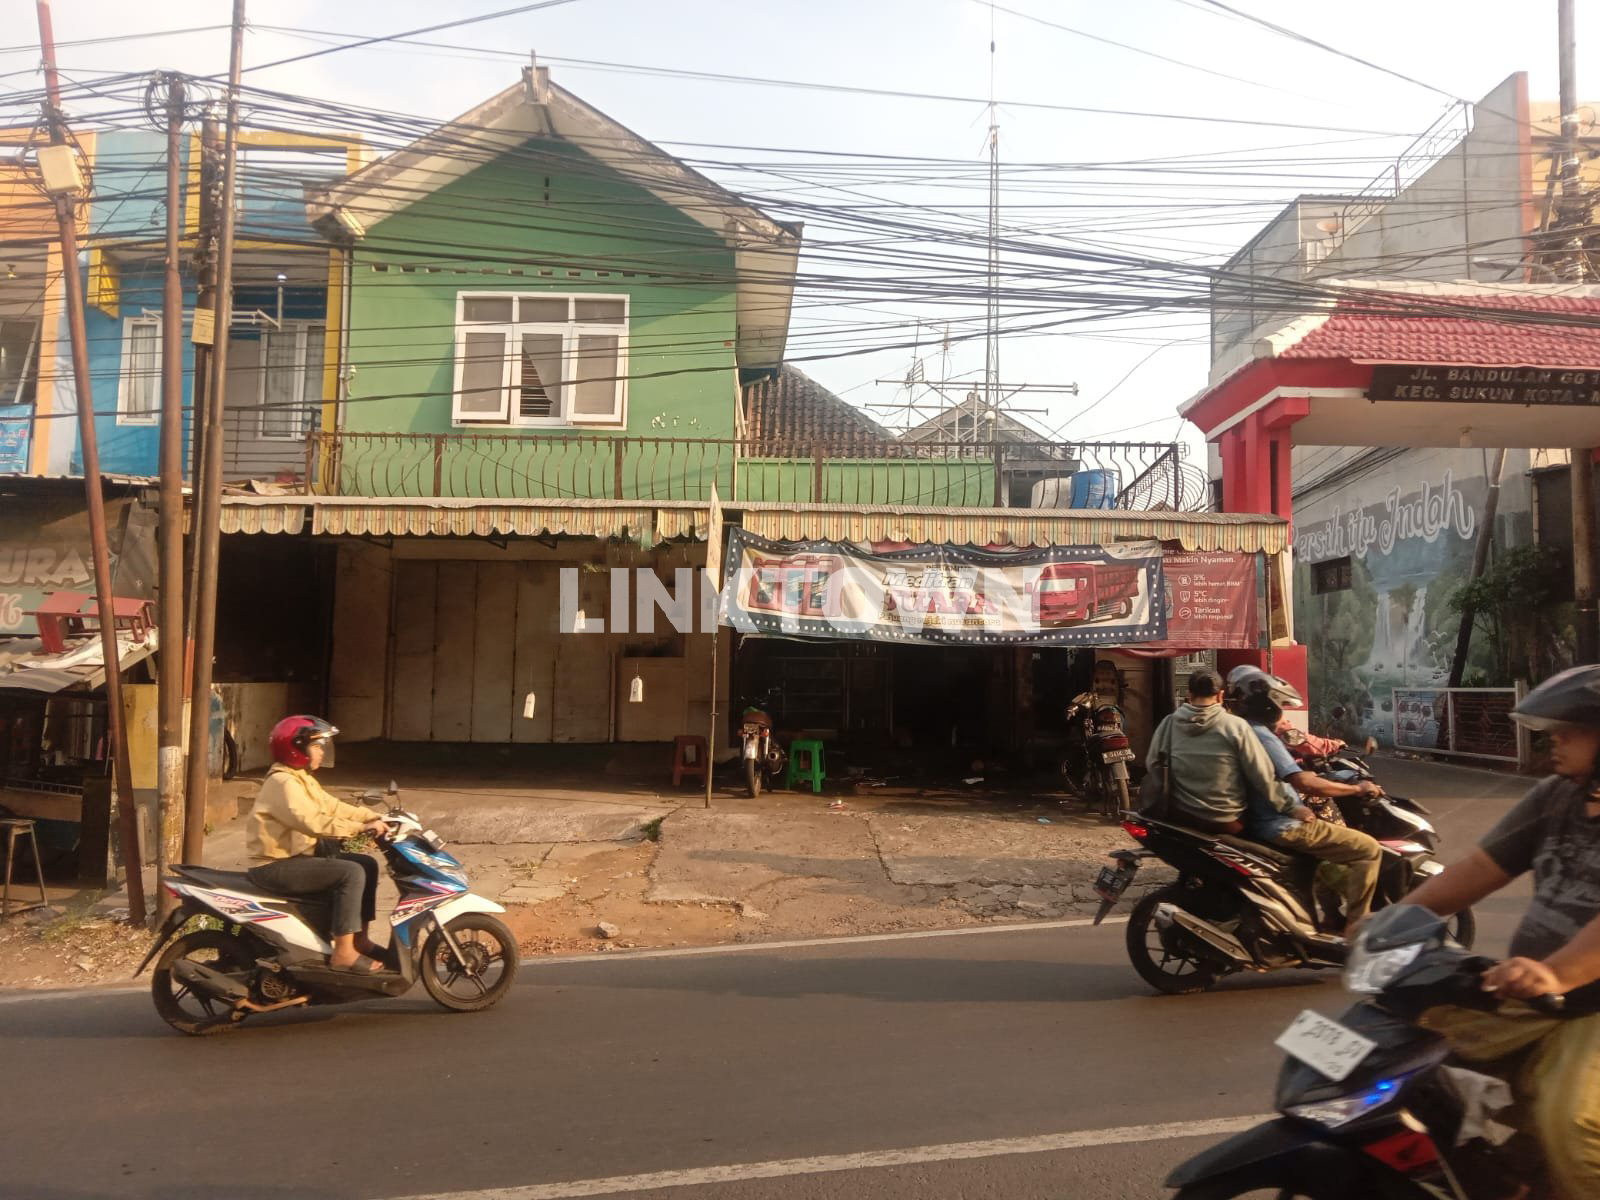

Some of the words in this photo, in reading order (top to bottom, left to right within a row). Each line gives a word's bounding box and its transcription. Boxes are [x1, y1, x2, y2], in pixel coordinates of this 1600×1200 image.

[1410, 369, 1438, 381] JL.
[1447, 369, 1551, 383] BANDULAN
[1394, 385, 1441, 399] KEC.
[1449, 386, 1514, 400] SUKUN
[1292, 505, 1348, 562] ersih
[1348, 506, 1378, 559] itu
[1378, 468, 1475, 556] Indah
[1200, 555, 1236, 566] Nyaman.
[881, 572, 975, 589] Meditran
